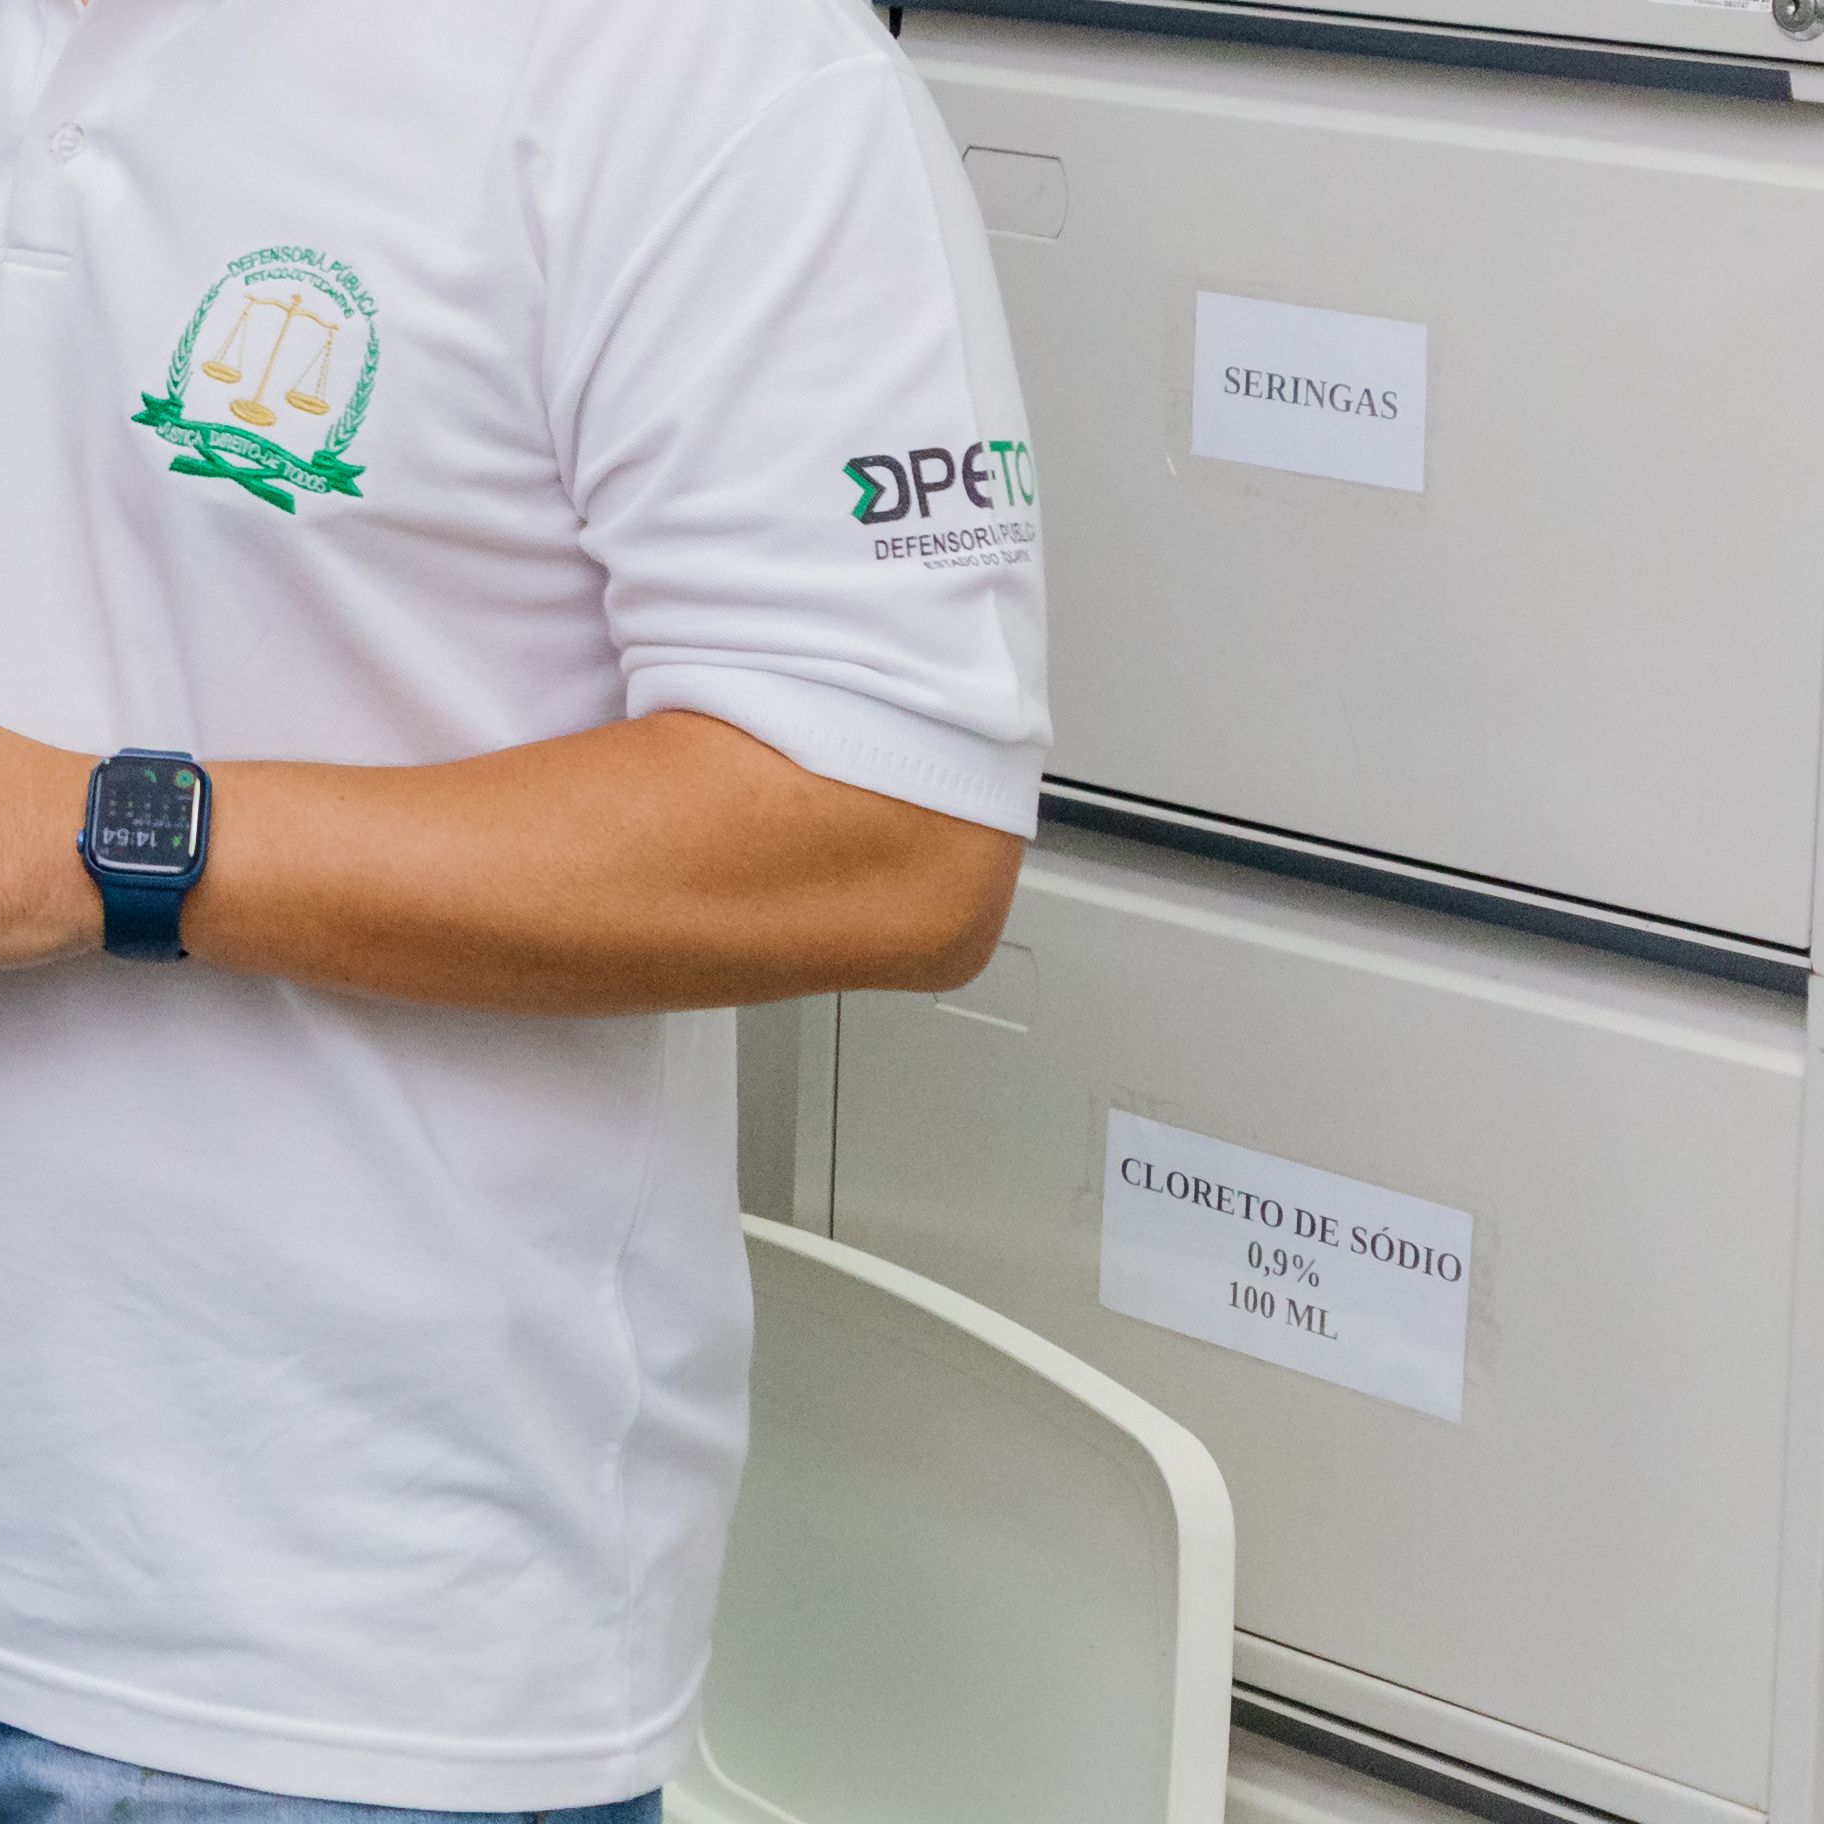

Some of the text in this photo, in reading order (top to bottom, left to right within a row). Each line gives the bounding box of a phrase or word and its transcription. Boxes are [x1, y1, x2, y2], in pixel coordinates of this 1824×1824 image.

[227, 246, 330, 276] DEFENSORIA
[1223, 366, 1399, 420] SERINGAS
[874, 524, 1000, 561] DEFENSORI
[103, 827, 157, 848] 14:54
[1121, 1157, 1463, 1283] CLORETO DE SÓDIO
[1247, 1241, 1321, 1288] 0,9%
[1228, 1280, 1339, 1340] 100 ML
